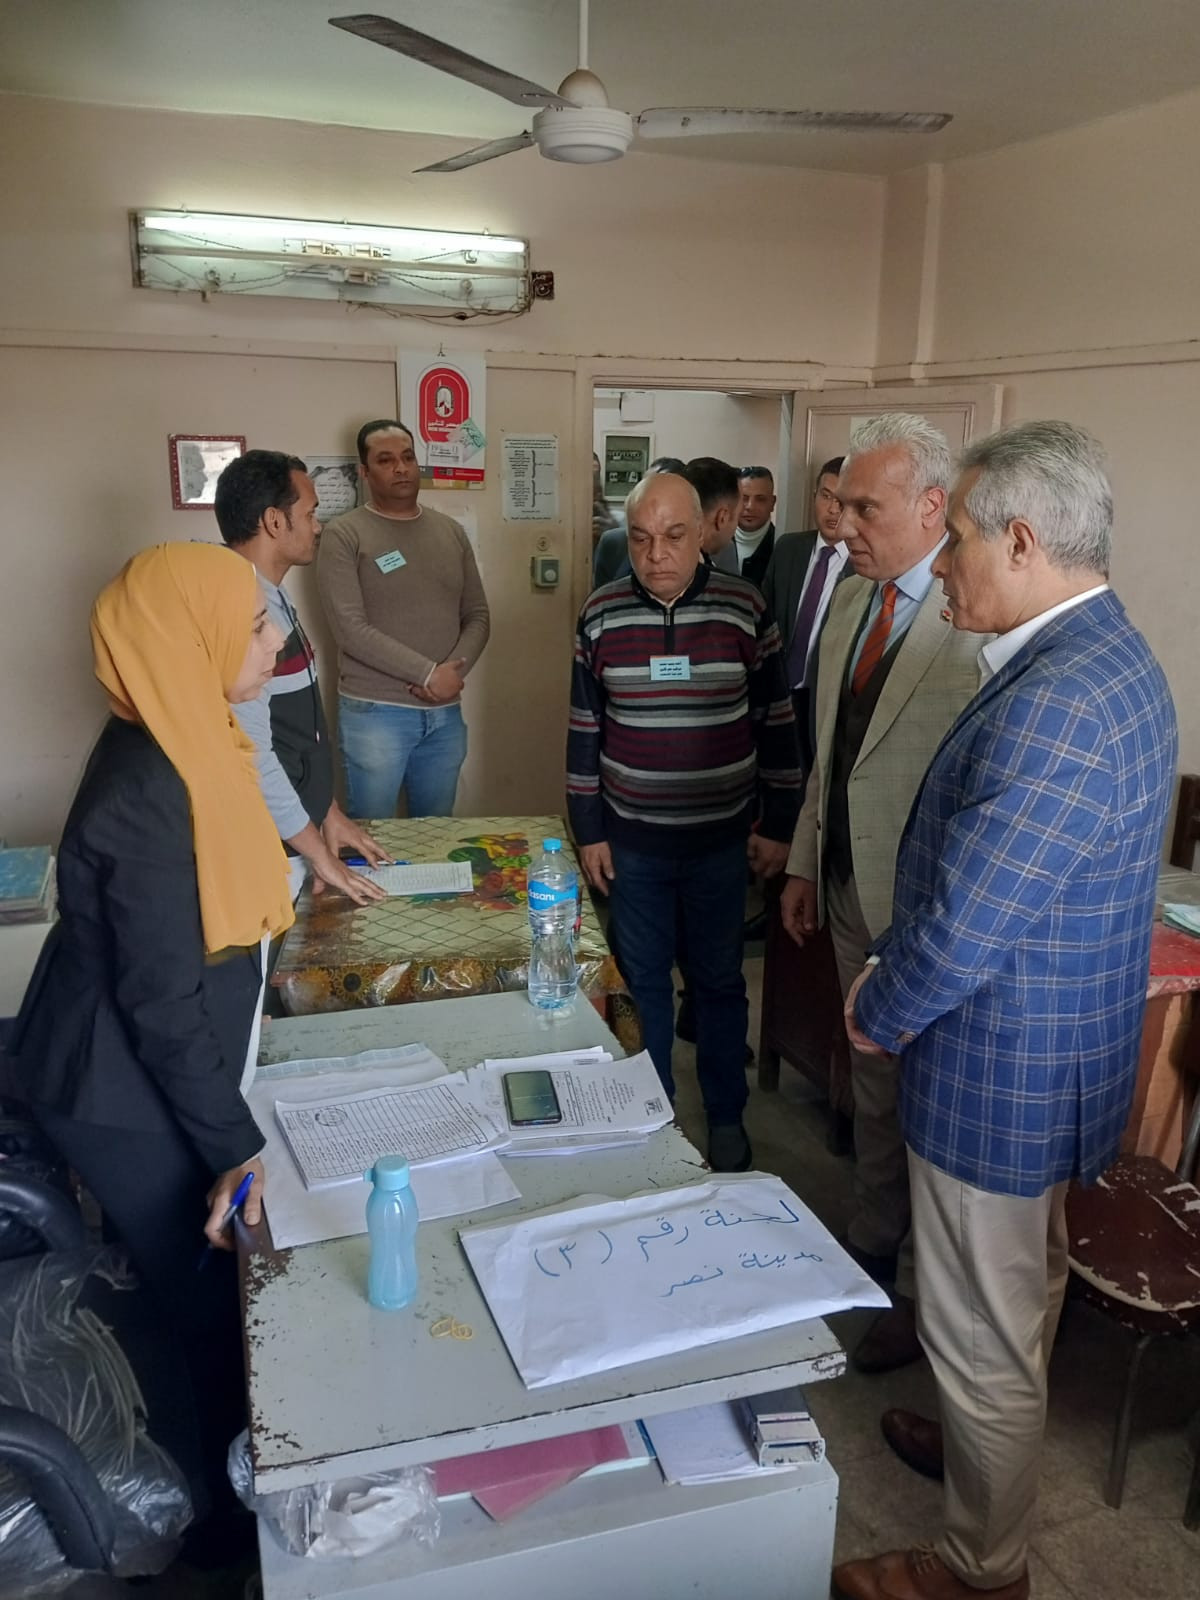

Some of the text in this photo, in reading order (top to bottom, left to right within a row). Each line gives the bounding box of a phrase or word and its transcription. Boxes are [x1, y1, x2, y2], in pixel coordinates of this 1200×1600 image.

[700, 1199, 800, 1227] لجنة
[637, 1216, 689, 1263] رقم
[658, 1251, 823, 1298] مدينة نصر
